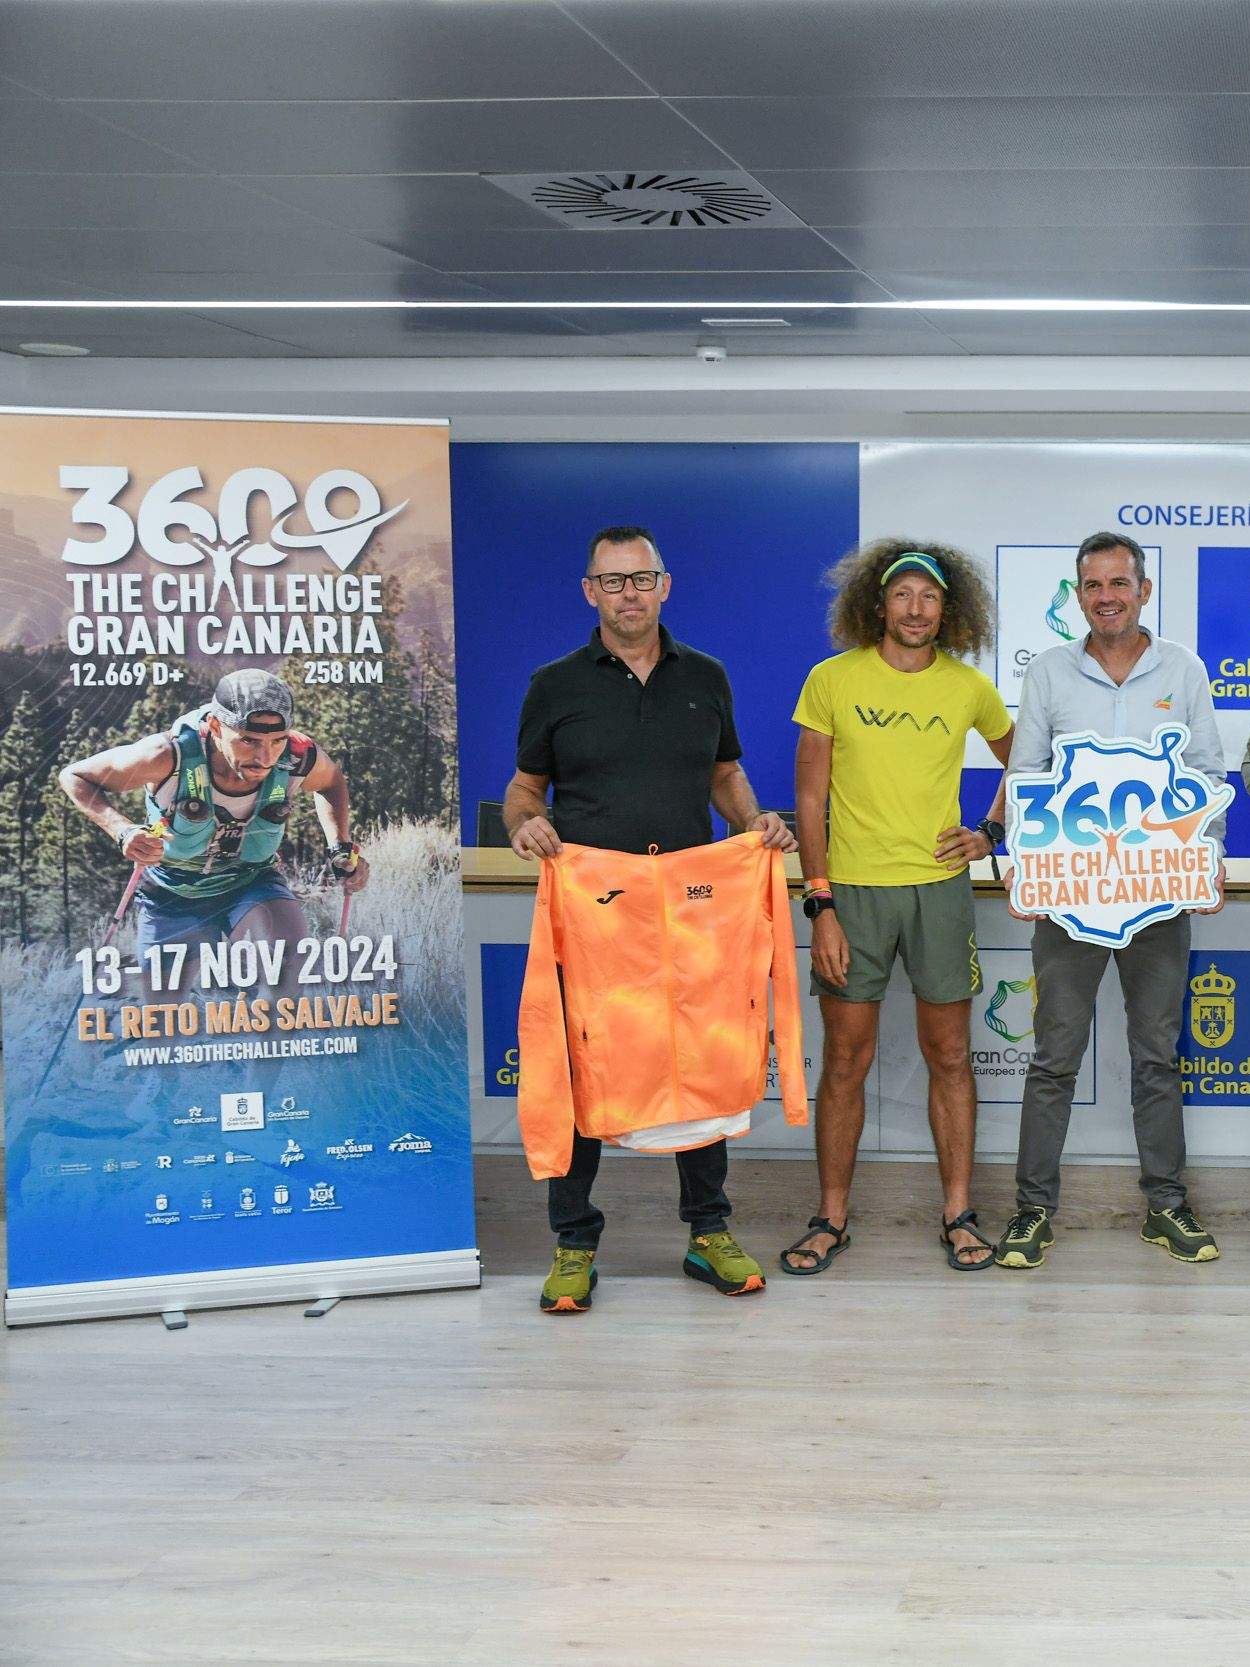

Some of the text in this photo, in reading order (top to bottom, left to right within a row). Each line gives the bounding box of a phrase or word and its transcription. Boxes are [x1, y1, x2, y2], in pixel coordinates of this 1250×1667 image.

[67, 574, 382, 613] THE CHALLENGE
[68, 616, 383, 656] GRAN CANARIA
[70, 662, 184, 686] 12.669 D+
[304, 660, 383, 684] 258 KM
[1021, 847, 1210, 879] THE CHALLENGE
[1020, 875, 1211, 907] GRAN CANARIA
[75, 935, 398, 995] 13-17 NOV 2024
[77, 992, 399, 1042] EL RETO MÁS SALVAJE
[124, 1037, 358, 1067] WWW.360THECHALLENGE.COM
[971, 1051, 1000, 1063] ran
[1180, 1056, 1234, 1075] bildo
[974, 1066, 1015, 1077] Europea
[271, 1206, 293, 1216] Teror
